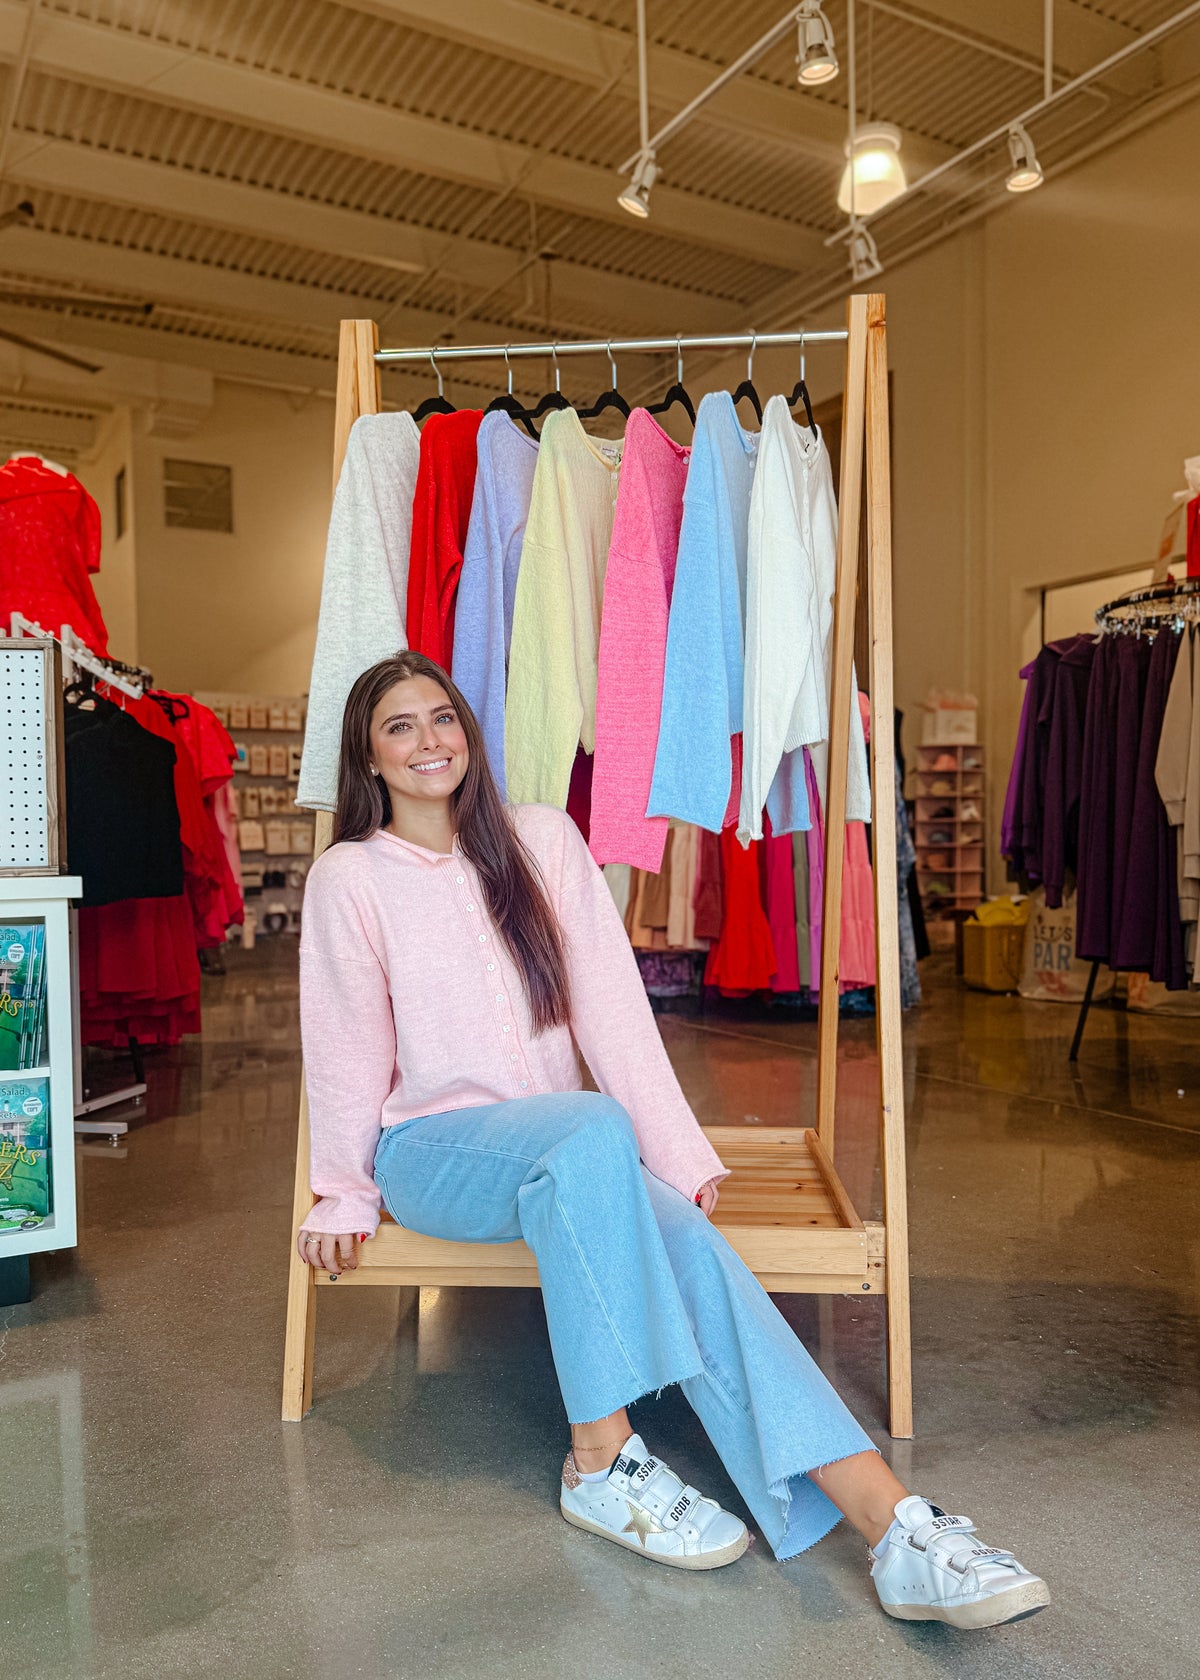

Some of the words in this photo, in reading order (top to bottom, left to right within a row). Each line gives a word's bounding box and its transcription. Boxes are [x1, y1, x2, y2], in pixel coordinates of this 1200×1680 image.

[1033, 943, 1072, 971] PAR
[636, 1458, 659, 1482] SSTAR
[931, 1516, 962, 1530] SSTAR
